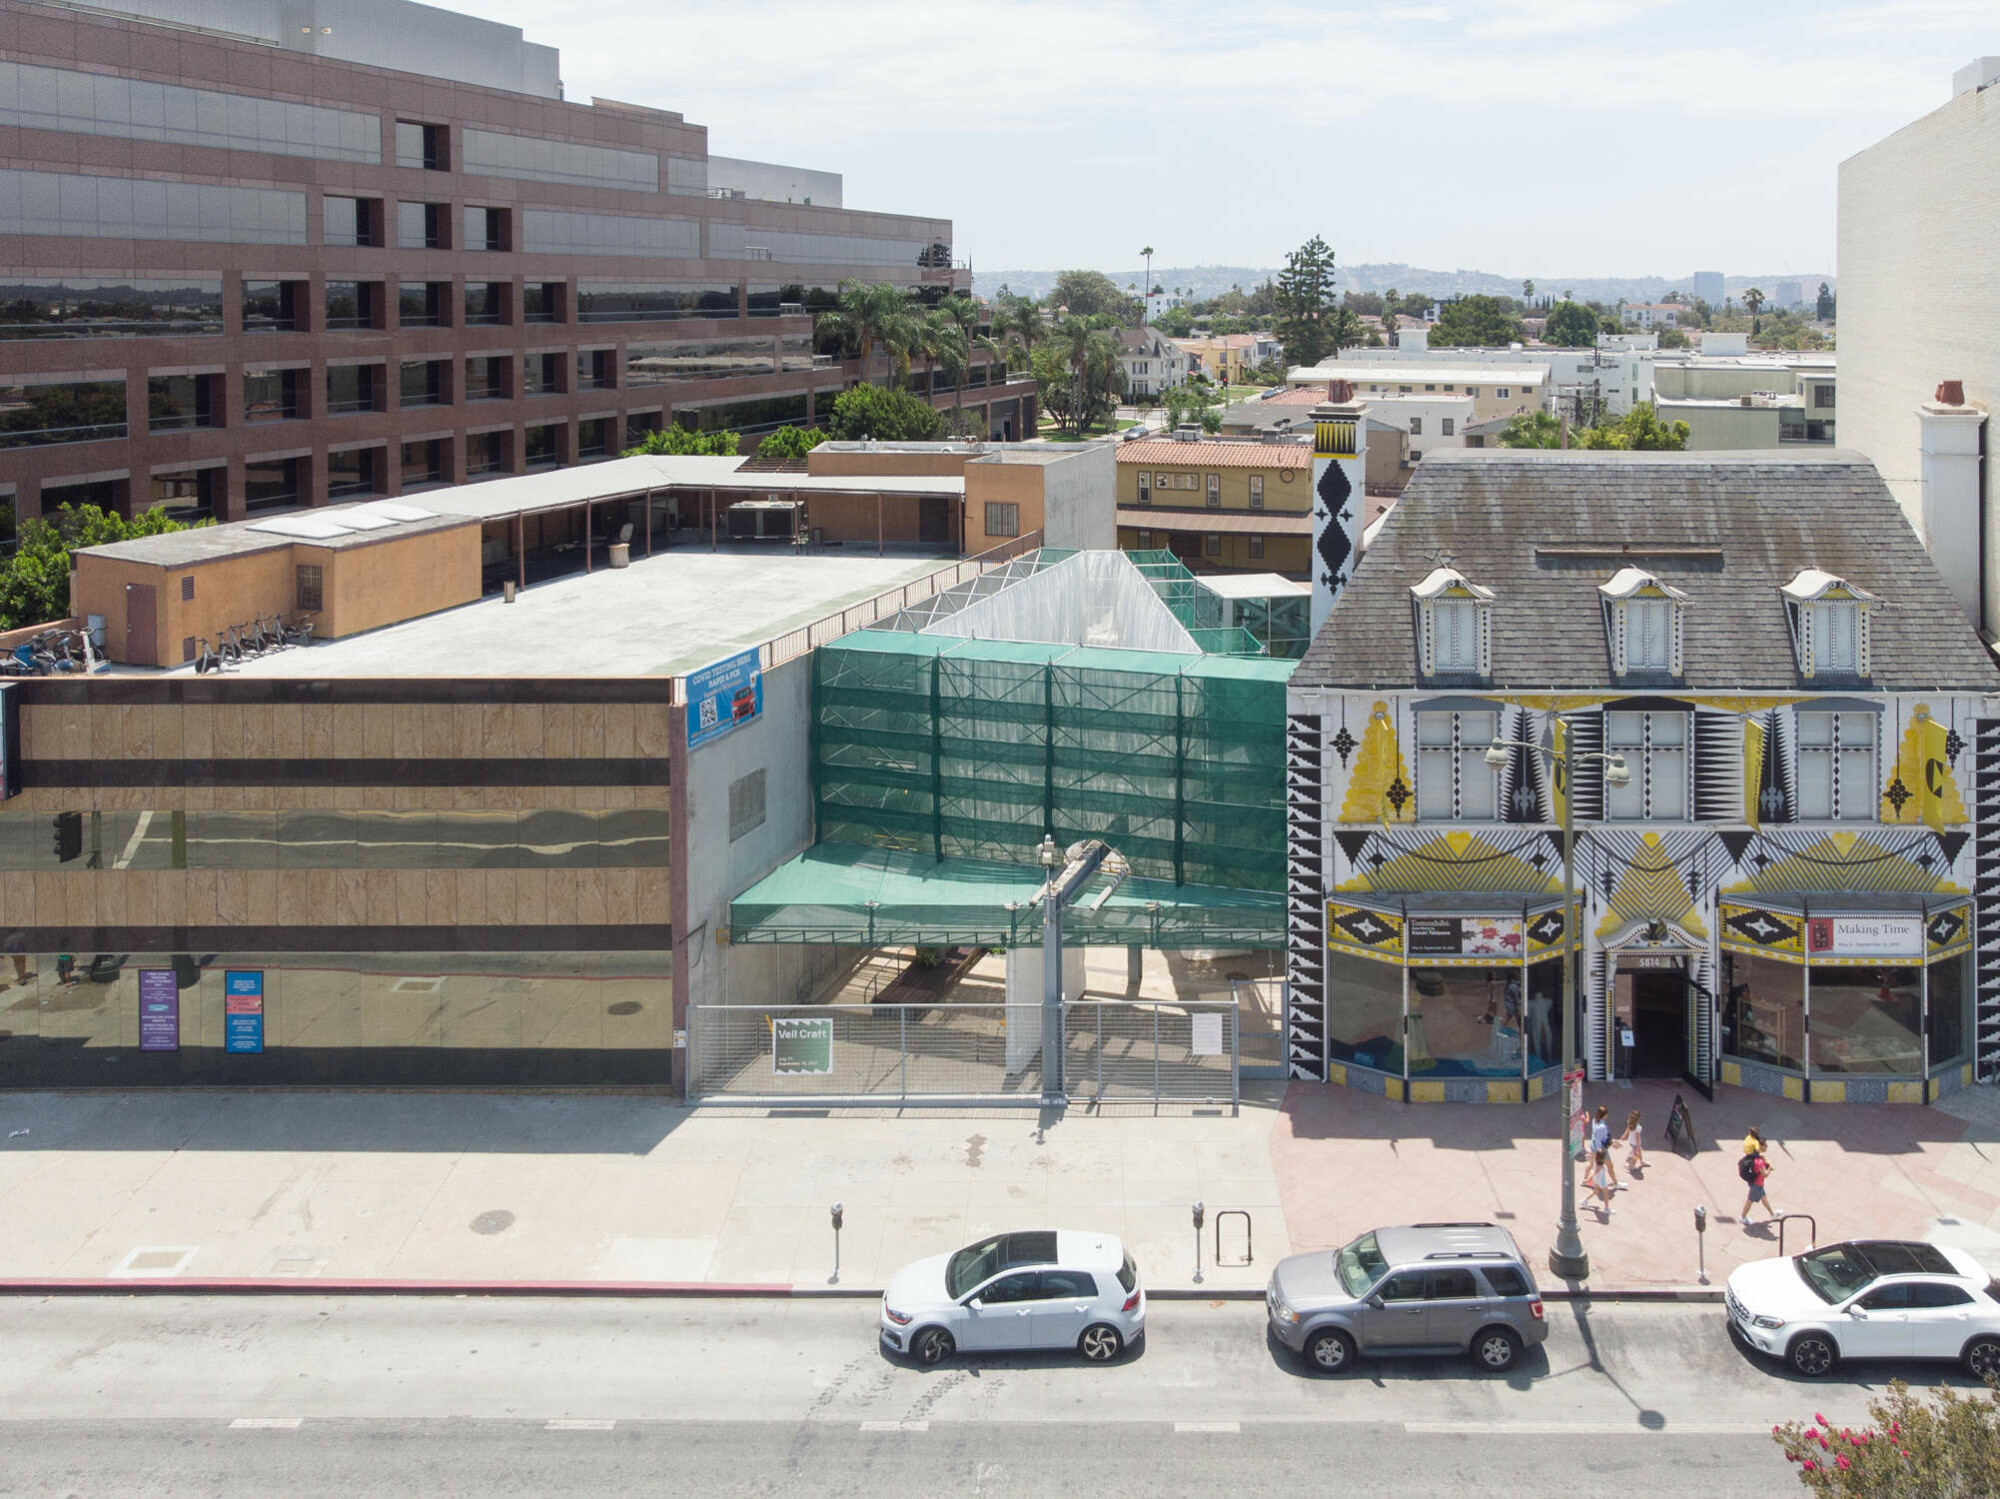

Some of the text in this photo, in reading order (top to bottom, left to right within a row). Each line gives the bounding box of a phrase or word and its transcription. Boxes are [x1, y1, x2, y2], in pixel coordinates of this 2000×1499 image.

[692, 671, 711, 684] COVID
[712, 661, 736, 677] TESTING
[708, 674, 724, 689] RAPID
[730, 668, 740, 679] PCR
[1838, 923, 1910, 937] Making Time
[1639, 957, 1660, 967] 5814
[778, 1029, 827, 1039] Veil Craft
